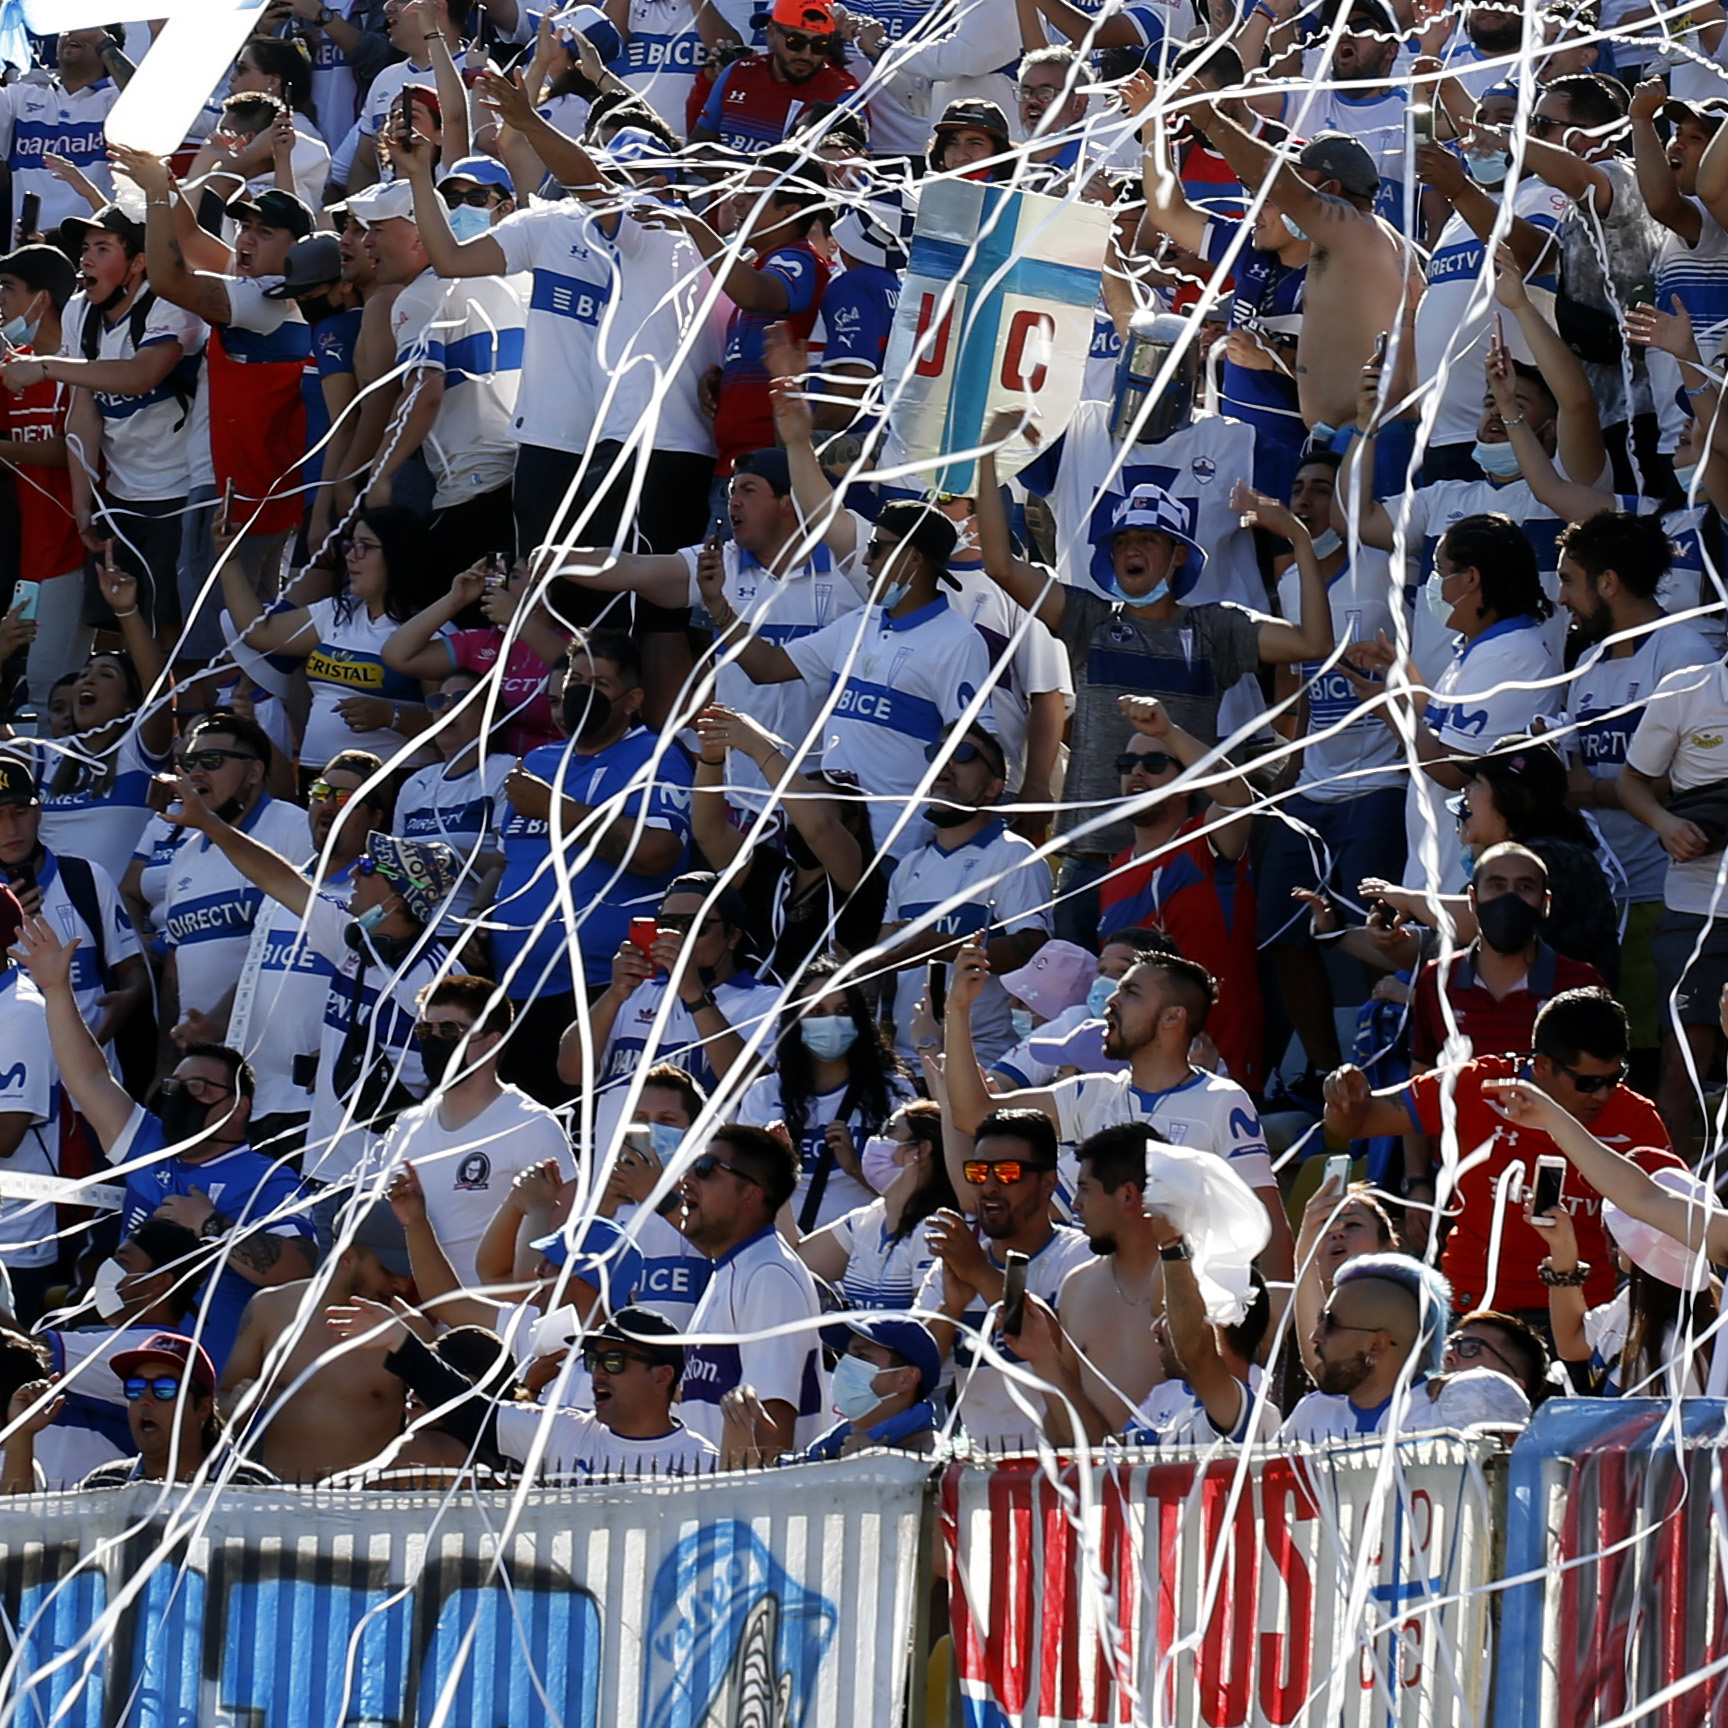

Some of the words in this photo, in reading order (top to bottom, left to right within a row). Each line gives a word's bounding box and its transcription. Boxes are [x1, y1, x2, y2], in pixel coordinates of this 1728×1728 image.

[647, 42, 704, 65] BICE
[16, 137, 103, 156] parmala
[1003, 310, 1057, 392] C
[306, 654, 374, 682] CRISTAL
[841, 690, 891, 719] BICE
[169, 900, 251, 938] DIRECTV
